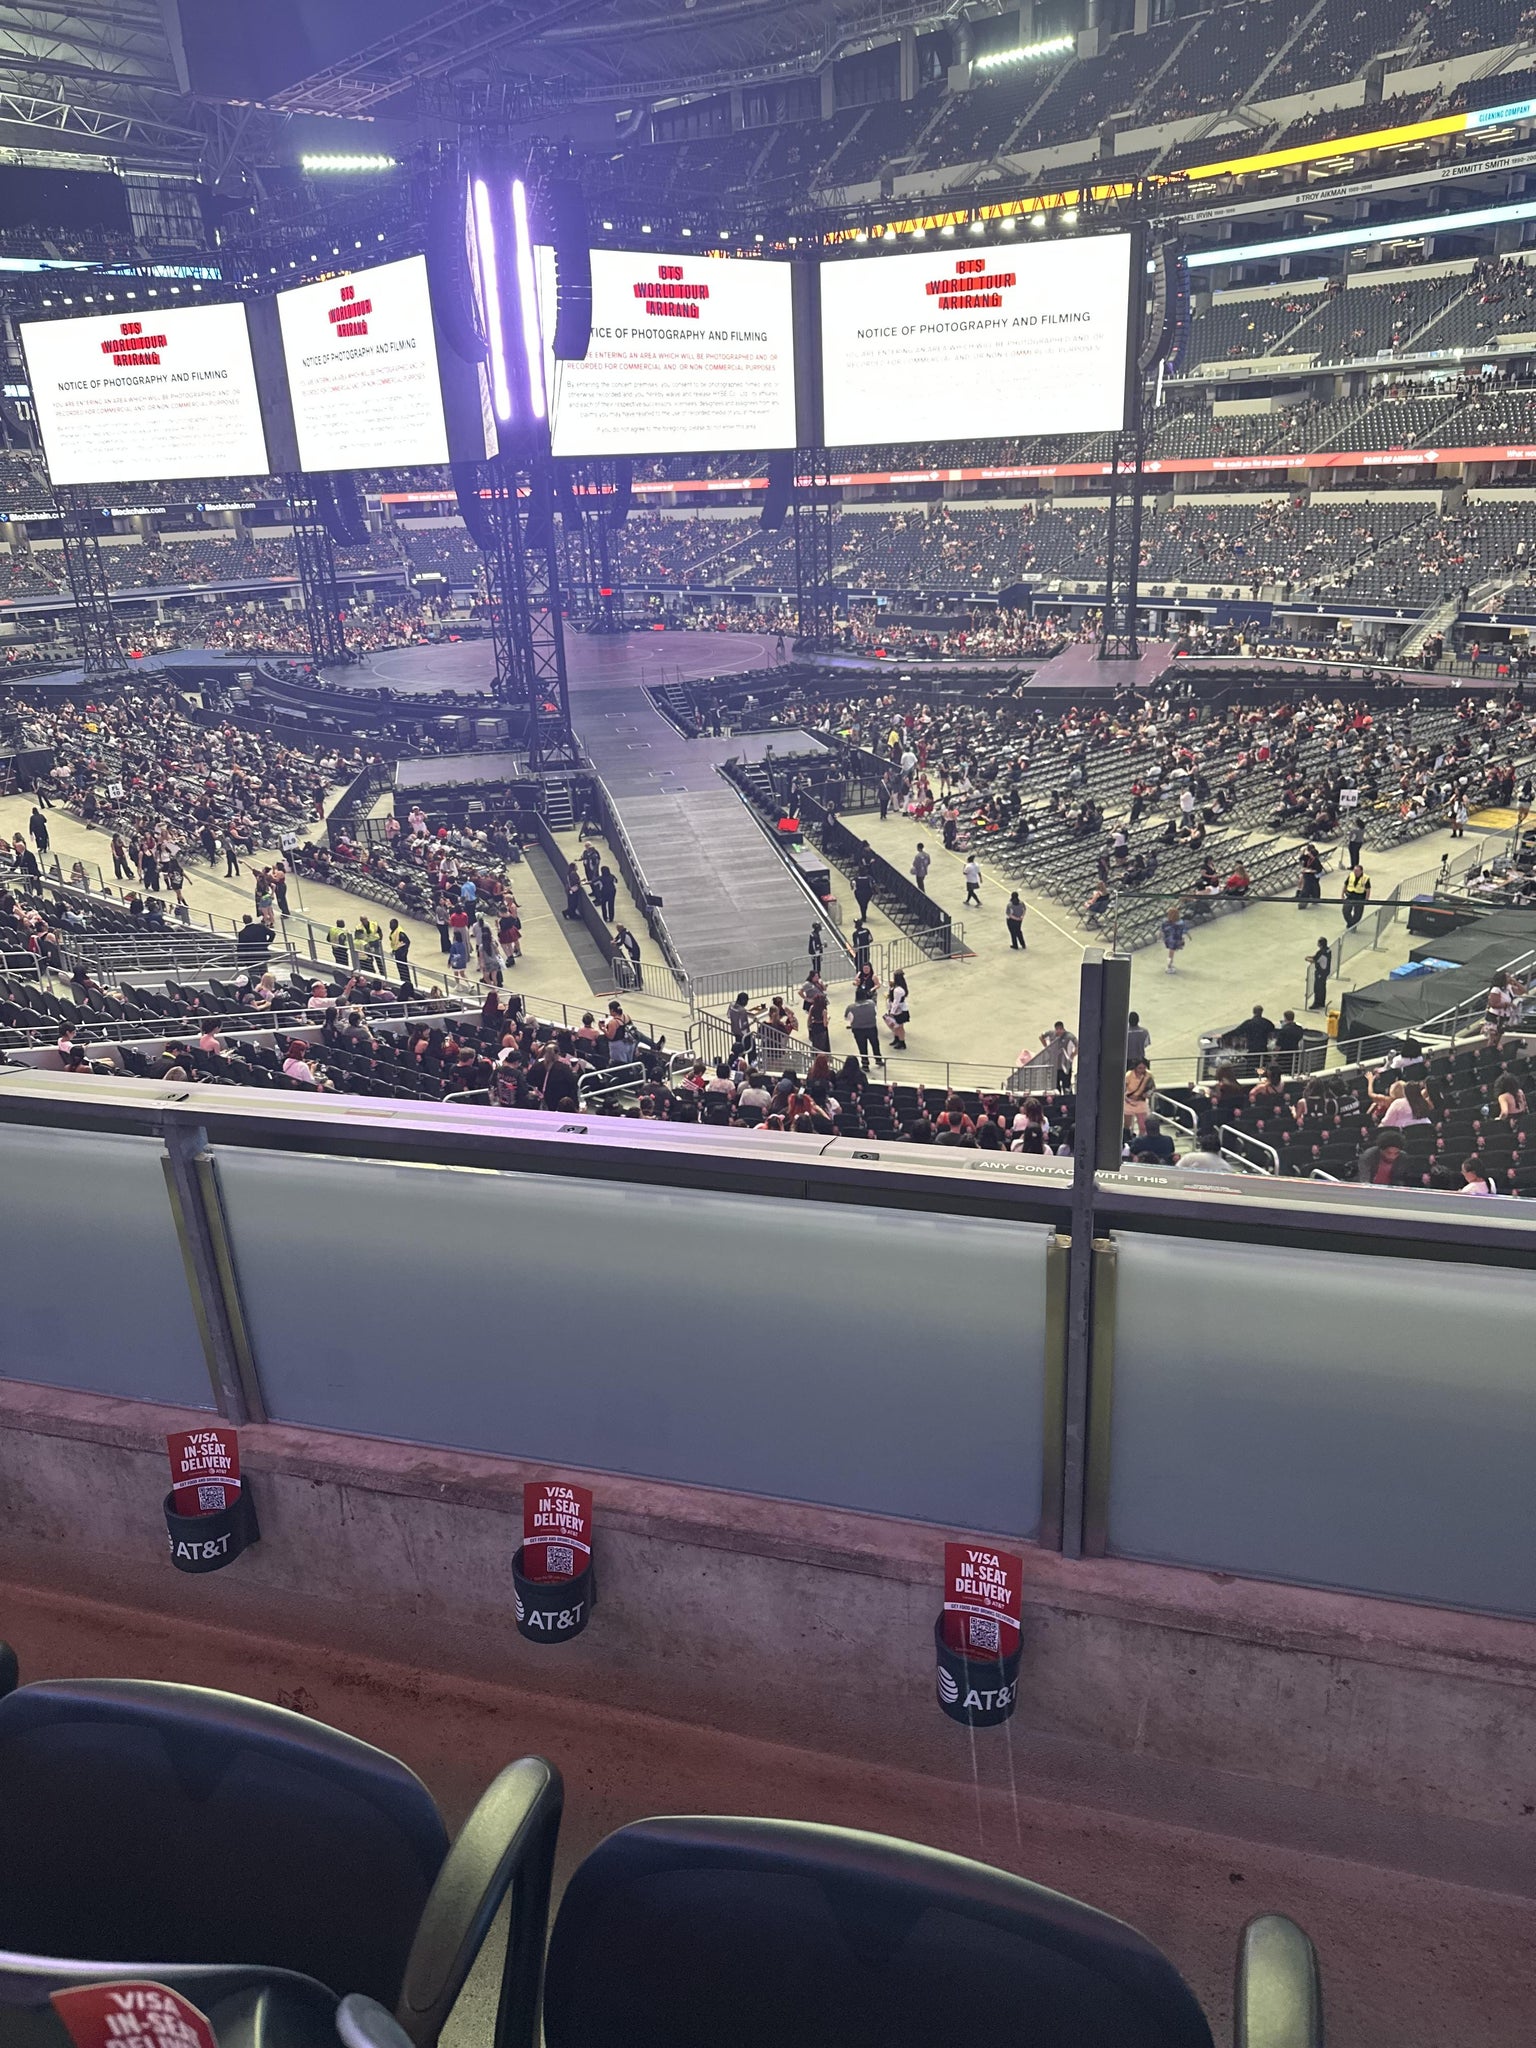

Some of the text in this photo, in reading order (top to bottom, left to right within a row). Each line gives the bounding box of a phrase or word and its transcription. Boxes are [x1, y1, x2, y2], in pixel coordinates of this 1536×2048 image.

[1479, 105, 1530, 122] CLEANING COMPANY
[1452, 163, 1483, 175] EMMITT
[1484, 159, 1510, 170] SMITH
[1302, 193, 1319, 202] TROY
[1320, 188, 1346, 199] AIKMAN
[661, 266, 682, 281] BTS
[958, 259, 982, 274] BTS
[637, 282, 706, 300] WORLD TOUR
[930, 273, 1012, 295] WORLD TOUR
[341, 285, 354, 302] BTS
[942, 293, 1000, 310] ARIRANG
[329, 300, 372, 323] WORLD TOUR
[650, 301, 697, 318] ARIRANG
[122, 323, 141, 336] BTS
[337, 320, 368, 337] ARIRANG
[857, 312, 1090, 339] NOTICE OF PHOTOGRAPHY AND FILMING
[590, 327, 767, 342] TICE OF PHOTOGRAPHY AND FILMING
[104, 335, 165, 353] WORLD TOUR
[302, 338, 416, 367] NOTICE OF PHOTOGRAPHY AND FILMING
[115, 352, 159, 367] ARIRANG
[567, 362, 602, 370] RECORDED
[58, 370, 228, 391] NOTICE OF PHOTOGRAPHY AND FILMING
[111, 507, 166, 516] Blockchain.com
[979, 1161, 1010, 1170] ANY
[1015, 1165, 1074, 1176] CONTAC
[1134, 1176, 1168, 1184] THIS
[186, 1433, 218, 1444] VISA
[184, 1444, 226, 1458] IN-SEAT
[181, 1457, 231, 1472] DELIVERY
[544, 1487, 574, 1499] VISA
[539, 1499, 580, 1516] IN-SEAT
[534, 1513, 584, 1532] DELIVERY
[176, 1533, 231, 1560] AT&T
[966, 1550, 1000, 1568] VISA
[961, 1563, 1007, 1586] IN-SEAT
[955, 1578, 1012, 1604] DELIVERY
[528, 1601, 584, 1630] AT&T
[963, 1678, 1019, 1711] AT&T
[106, 1991, 182, 2018] VISA
